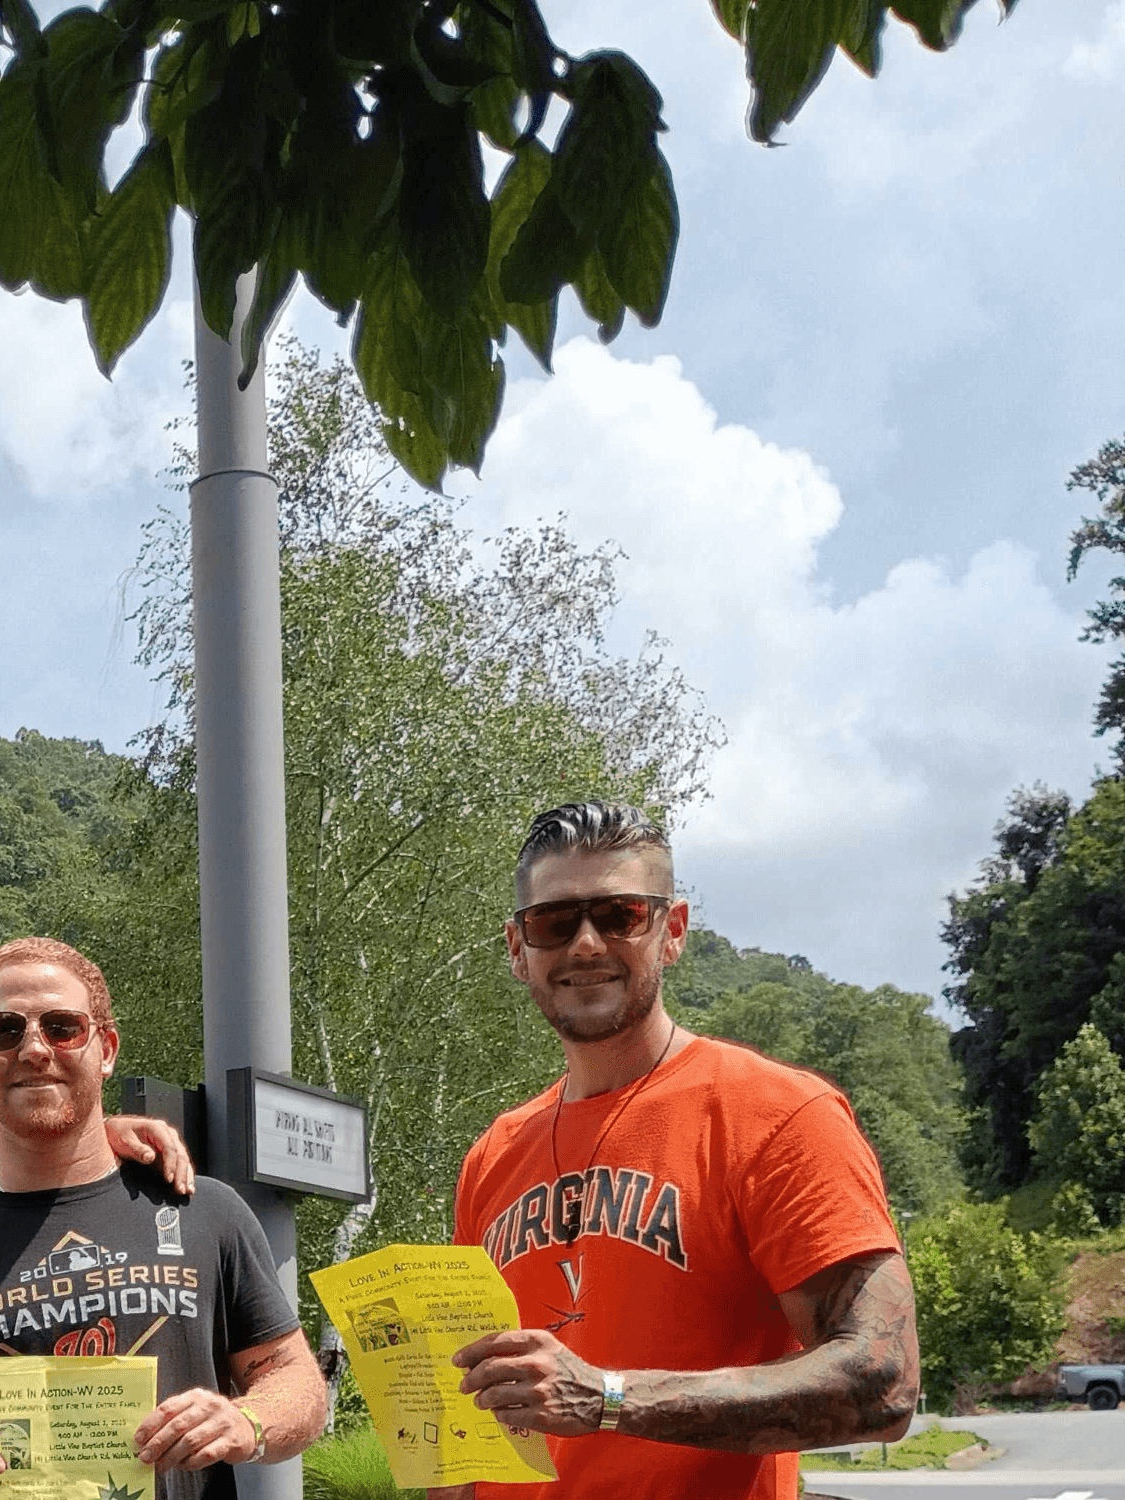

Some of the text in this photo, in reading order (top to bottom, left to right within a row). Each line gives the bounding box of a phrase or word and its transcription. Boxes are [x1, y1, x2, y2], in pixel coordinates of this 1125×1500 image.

[85, 1264, 198, 1291] SERIES
[348, 1272, 376, 1288] LOVE
[0, 1384, 124, 1399] LOVE IN ACTION-WV 2025
